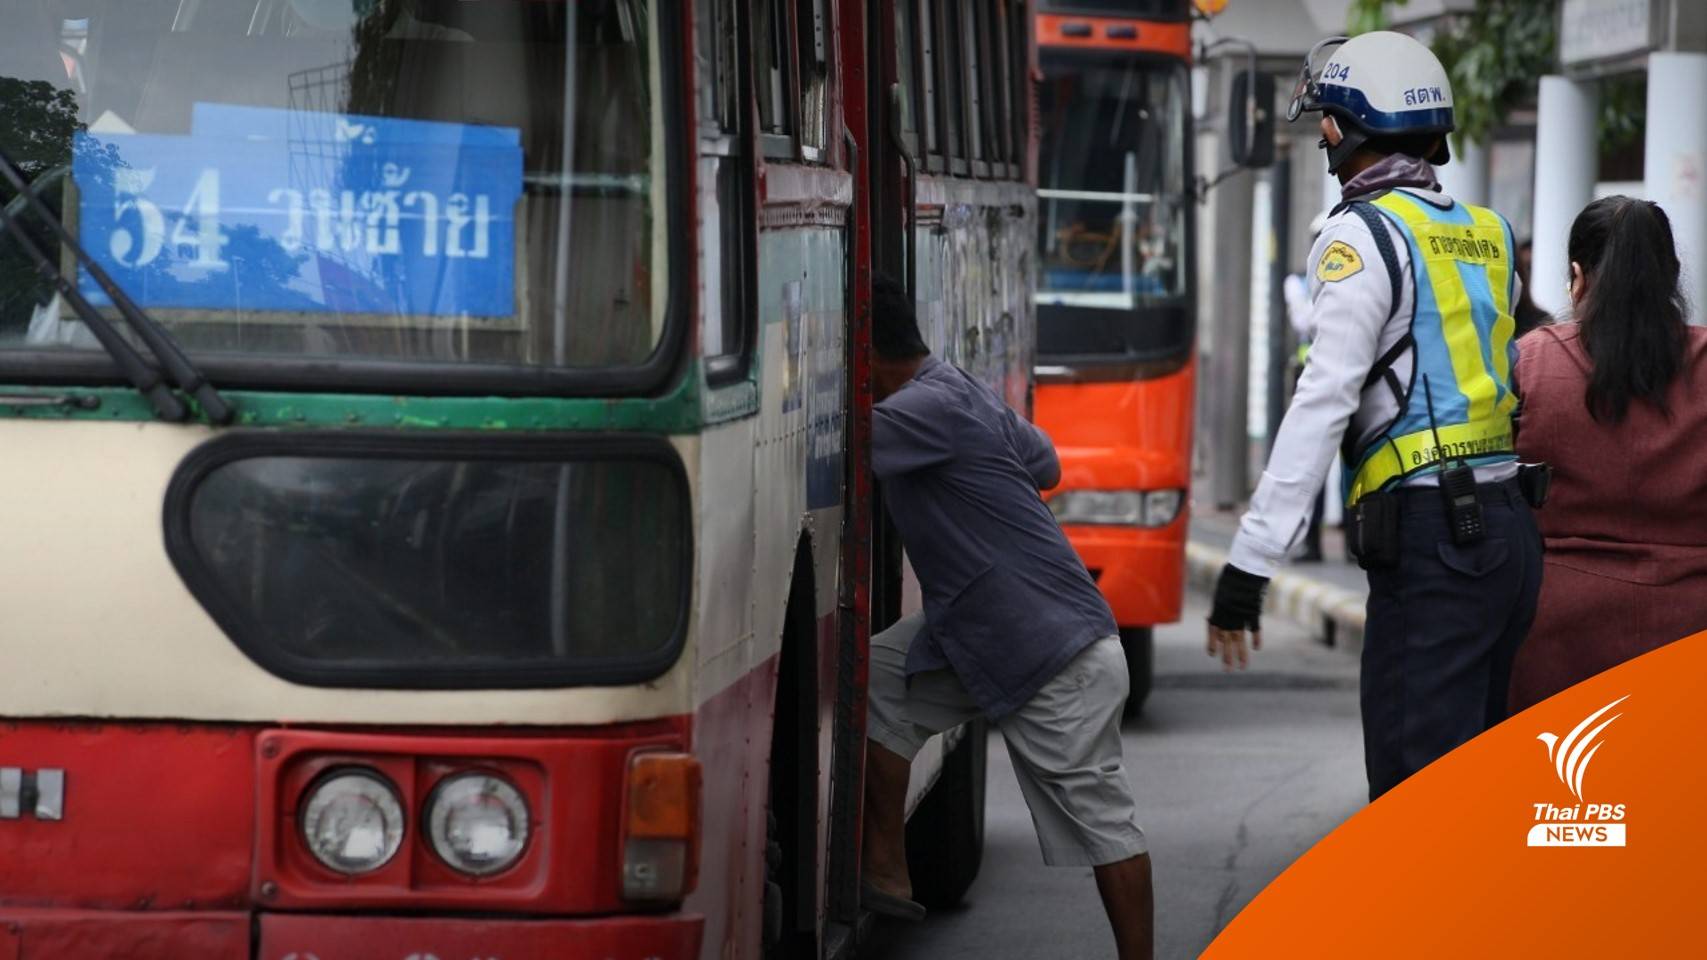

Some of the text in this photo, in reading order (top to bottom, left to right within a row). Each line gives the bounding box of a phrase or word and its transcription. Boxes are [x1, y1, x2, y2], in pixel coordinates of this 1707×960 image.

[1324, 62, 1350, 81] 204
[109, 162, 490, 268] 54 วนซ้าย
